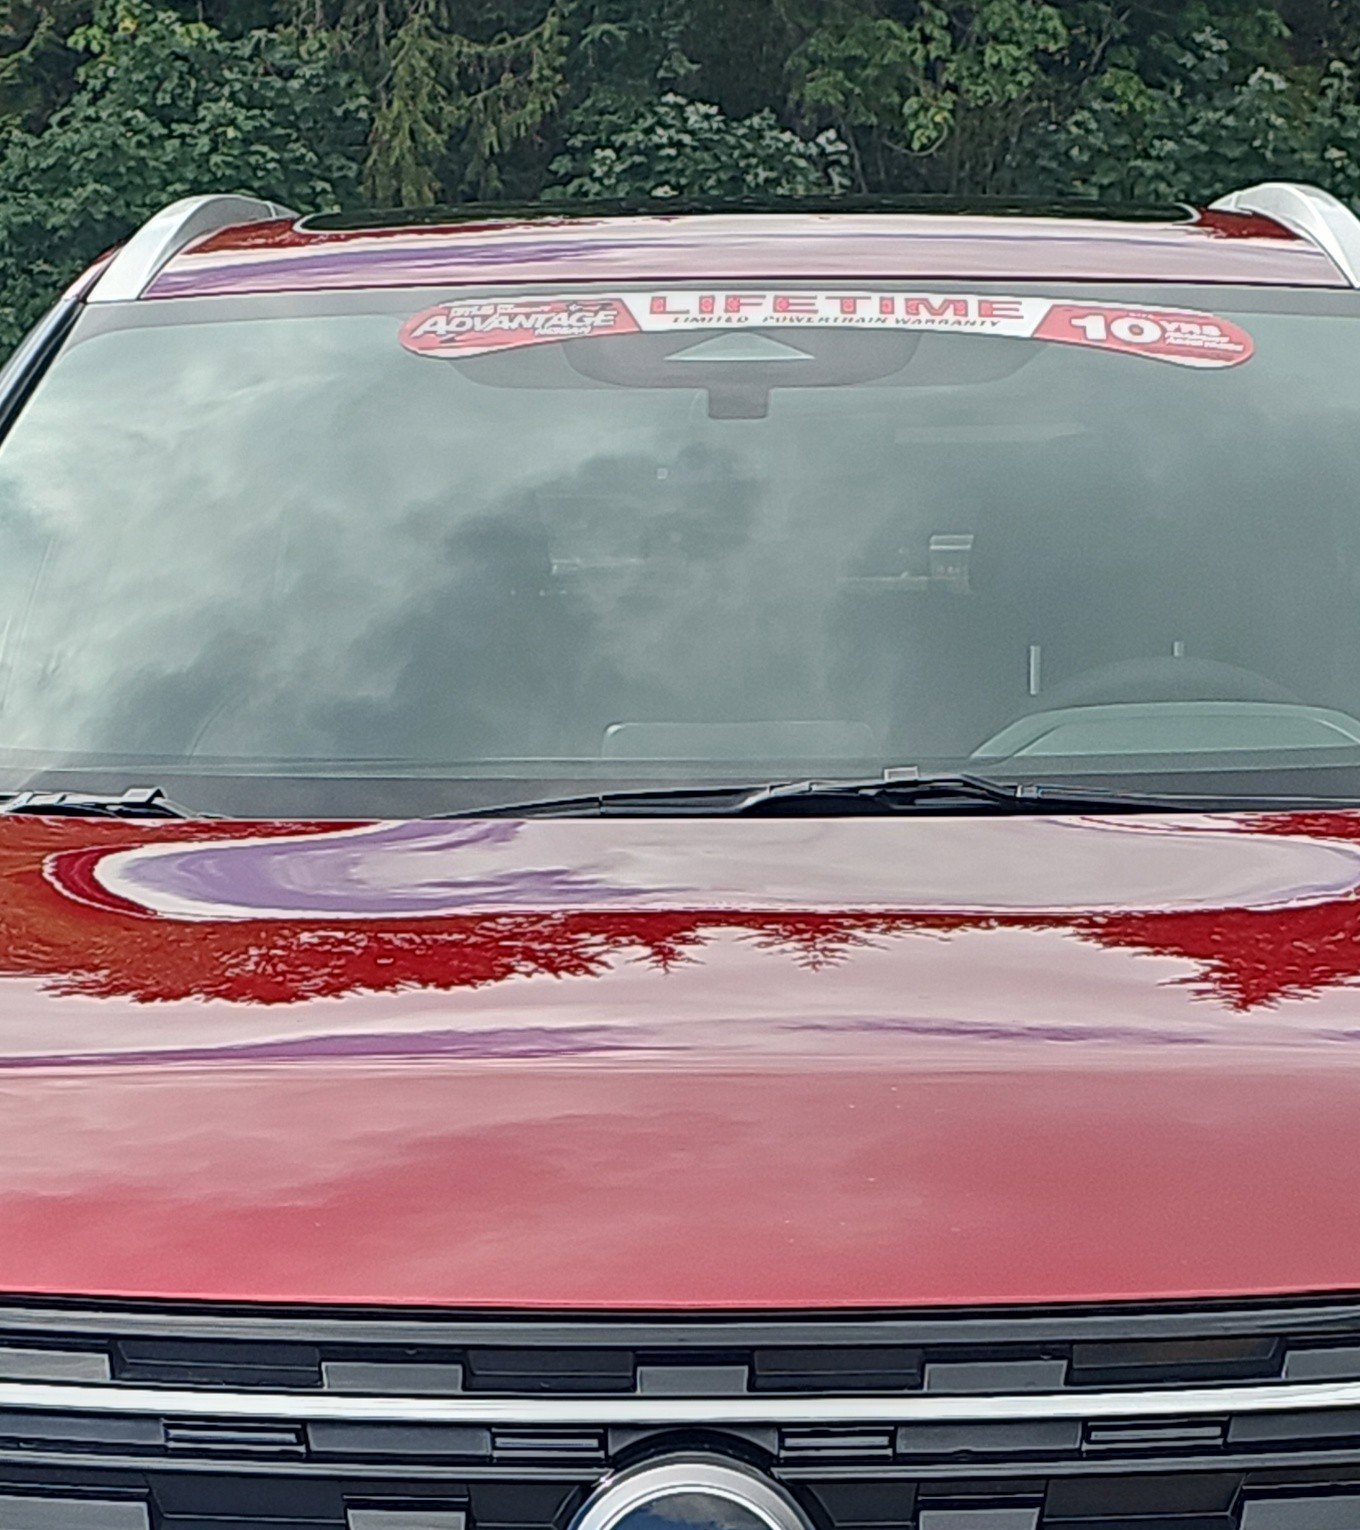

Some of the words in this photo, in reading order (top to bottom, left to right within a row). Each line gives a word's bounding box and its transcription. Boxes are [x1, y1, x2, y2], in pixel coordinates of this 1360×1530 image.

[649, 294, 1025, 320] LIFETIME
[410, 310, 618, 339] ADVANTAGE
[672, 315, 750, 324] LIMITED
[894, 317, 1001, 327] WARRANTY
[1070, 314, 1162, 344] 10
